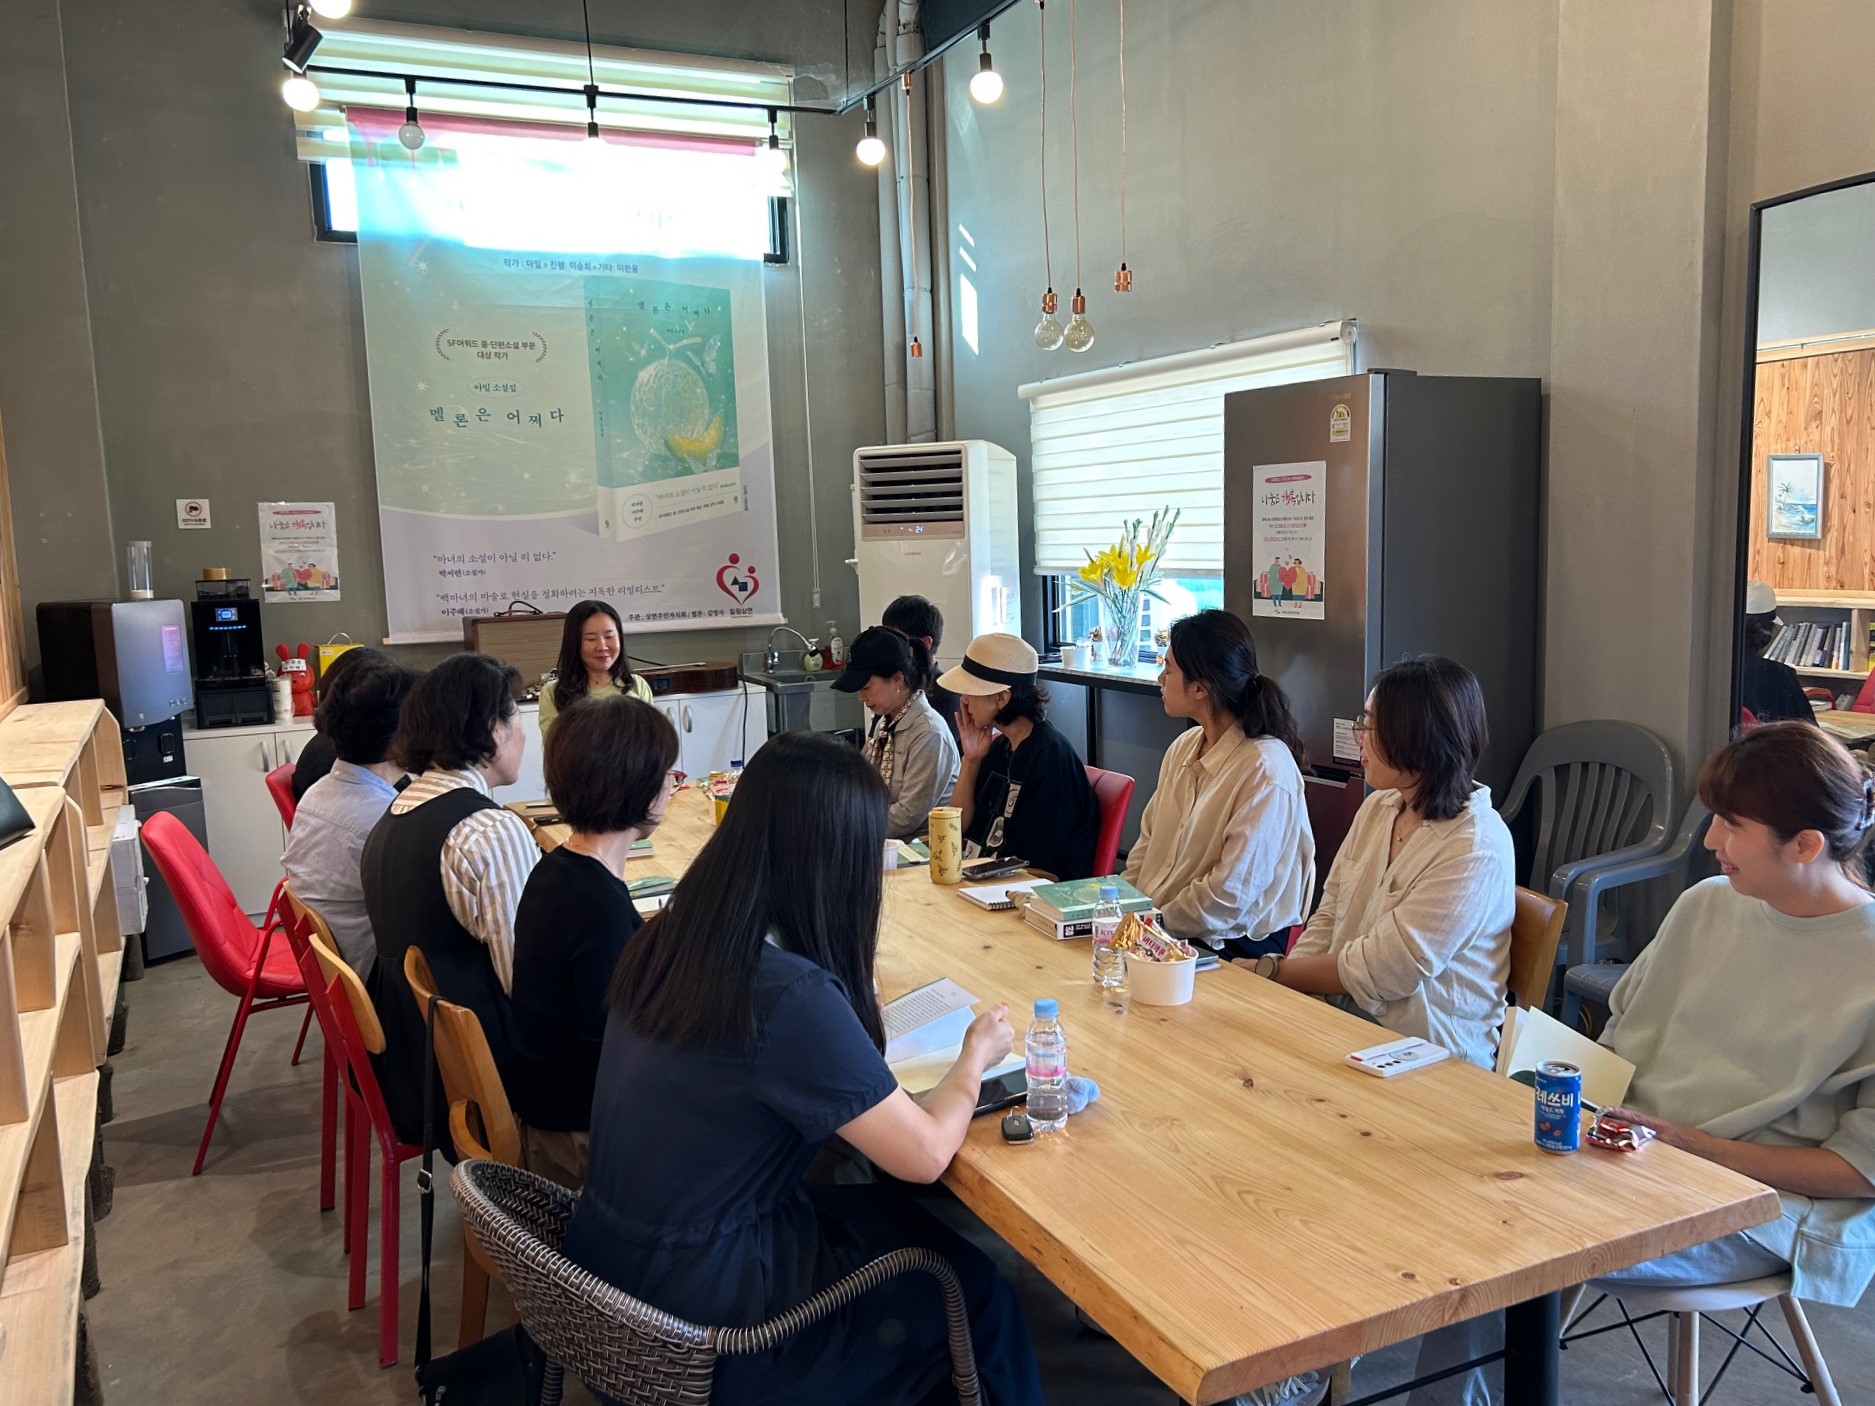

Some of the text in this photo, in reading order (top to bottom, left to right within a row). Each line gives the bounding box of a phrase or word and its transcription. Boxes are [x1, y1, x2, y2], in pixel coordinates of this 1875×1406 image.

[504, 258, 519, 268] 작가
[525, 259, 542, 269] 아밀
[446, 338, 479, 348] SF어워드
[521, 341, 536, 351] 부문
[477, 351, 509, 360] 대상 작가
[474, 383, 517, 393] 아밀 소설집
[429, 406, 564, 428] 멜론은 어쩌다
[467, 553, 496, 563] 소설이
[499, 552, 518, 563] 아닐
[521, 552, 530, 562] 리
[480, 592, 509, 602] 마술로
[511, 590, 540, 601] 현실을
[542, 588, 587, 600] 정화하려는
[589, 586, 614, 597] 지독한
[1536, 1086, 1574, 1108] 레쓰비
